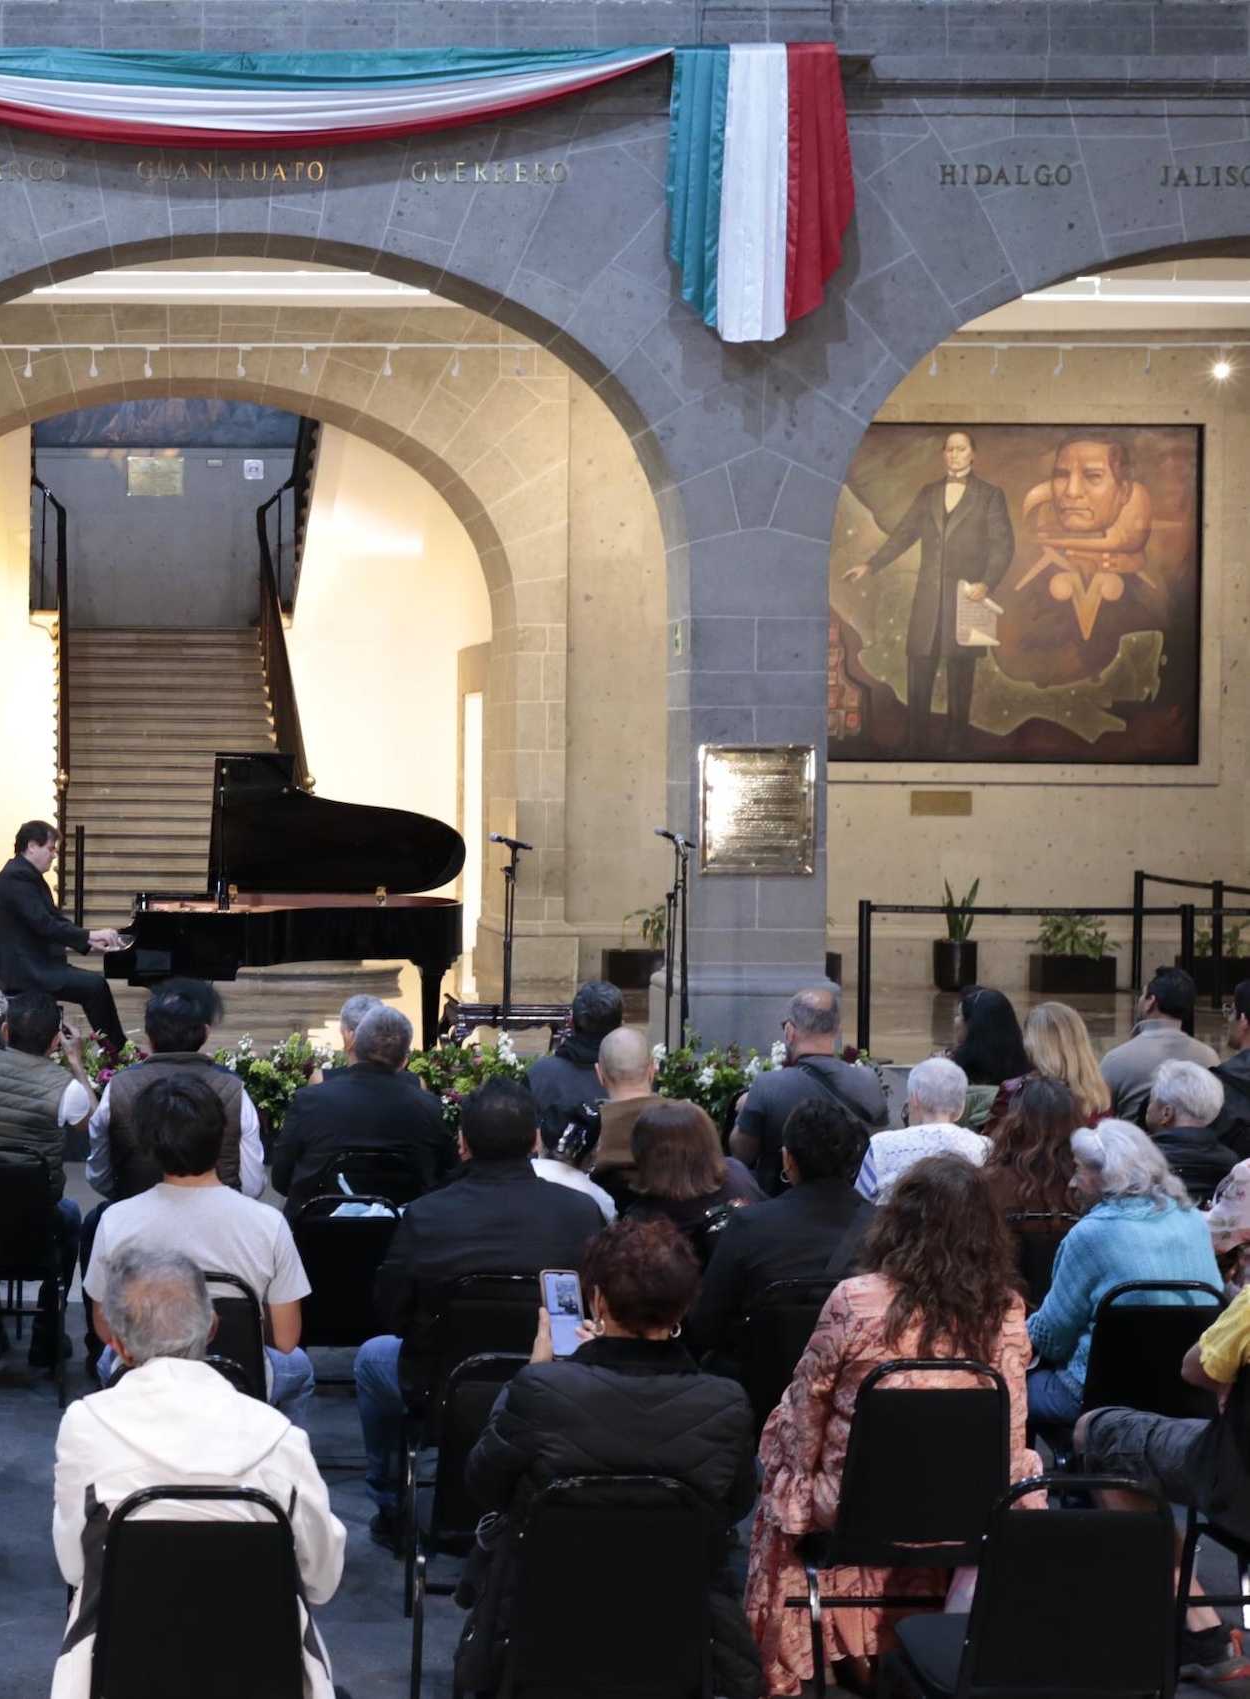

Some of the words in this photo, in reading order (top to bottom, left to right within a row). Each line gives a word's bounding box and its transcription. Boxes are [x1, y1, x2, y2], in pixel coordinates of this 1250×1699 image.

[136, 160, 325, 183] GUANAJUATO
[410, 161, 569, 184] GUERRERO
[938, 163, 1073, 187] HIDALGO
